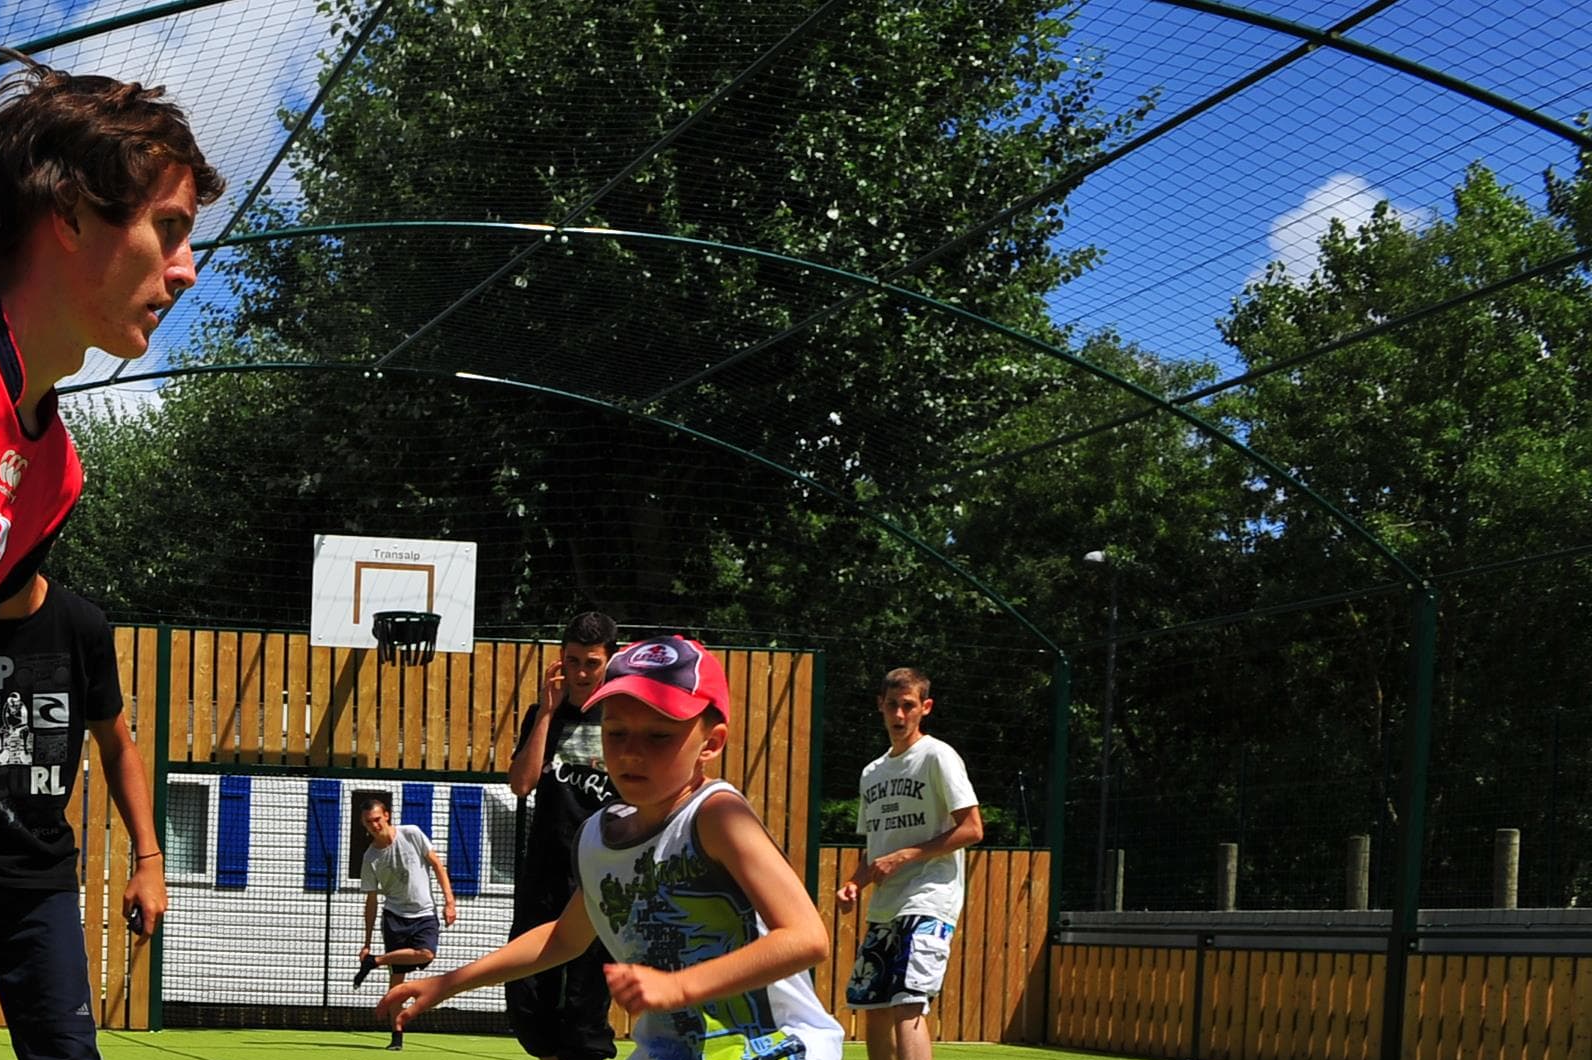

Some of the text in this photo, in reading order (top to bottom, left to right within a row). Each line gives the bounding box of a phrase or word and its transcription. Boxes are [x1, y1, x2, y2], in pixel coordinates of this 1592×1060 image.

[374, 549, 421, 562] Transalp
[863, 777, 926, 805] NEW YORK
[884, 811, 926, 831] DENIM
